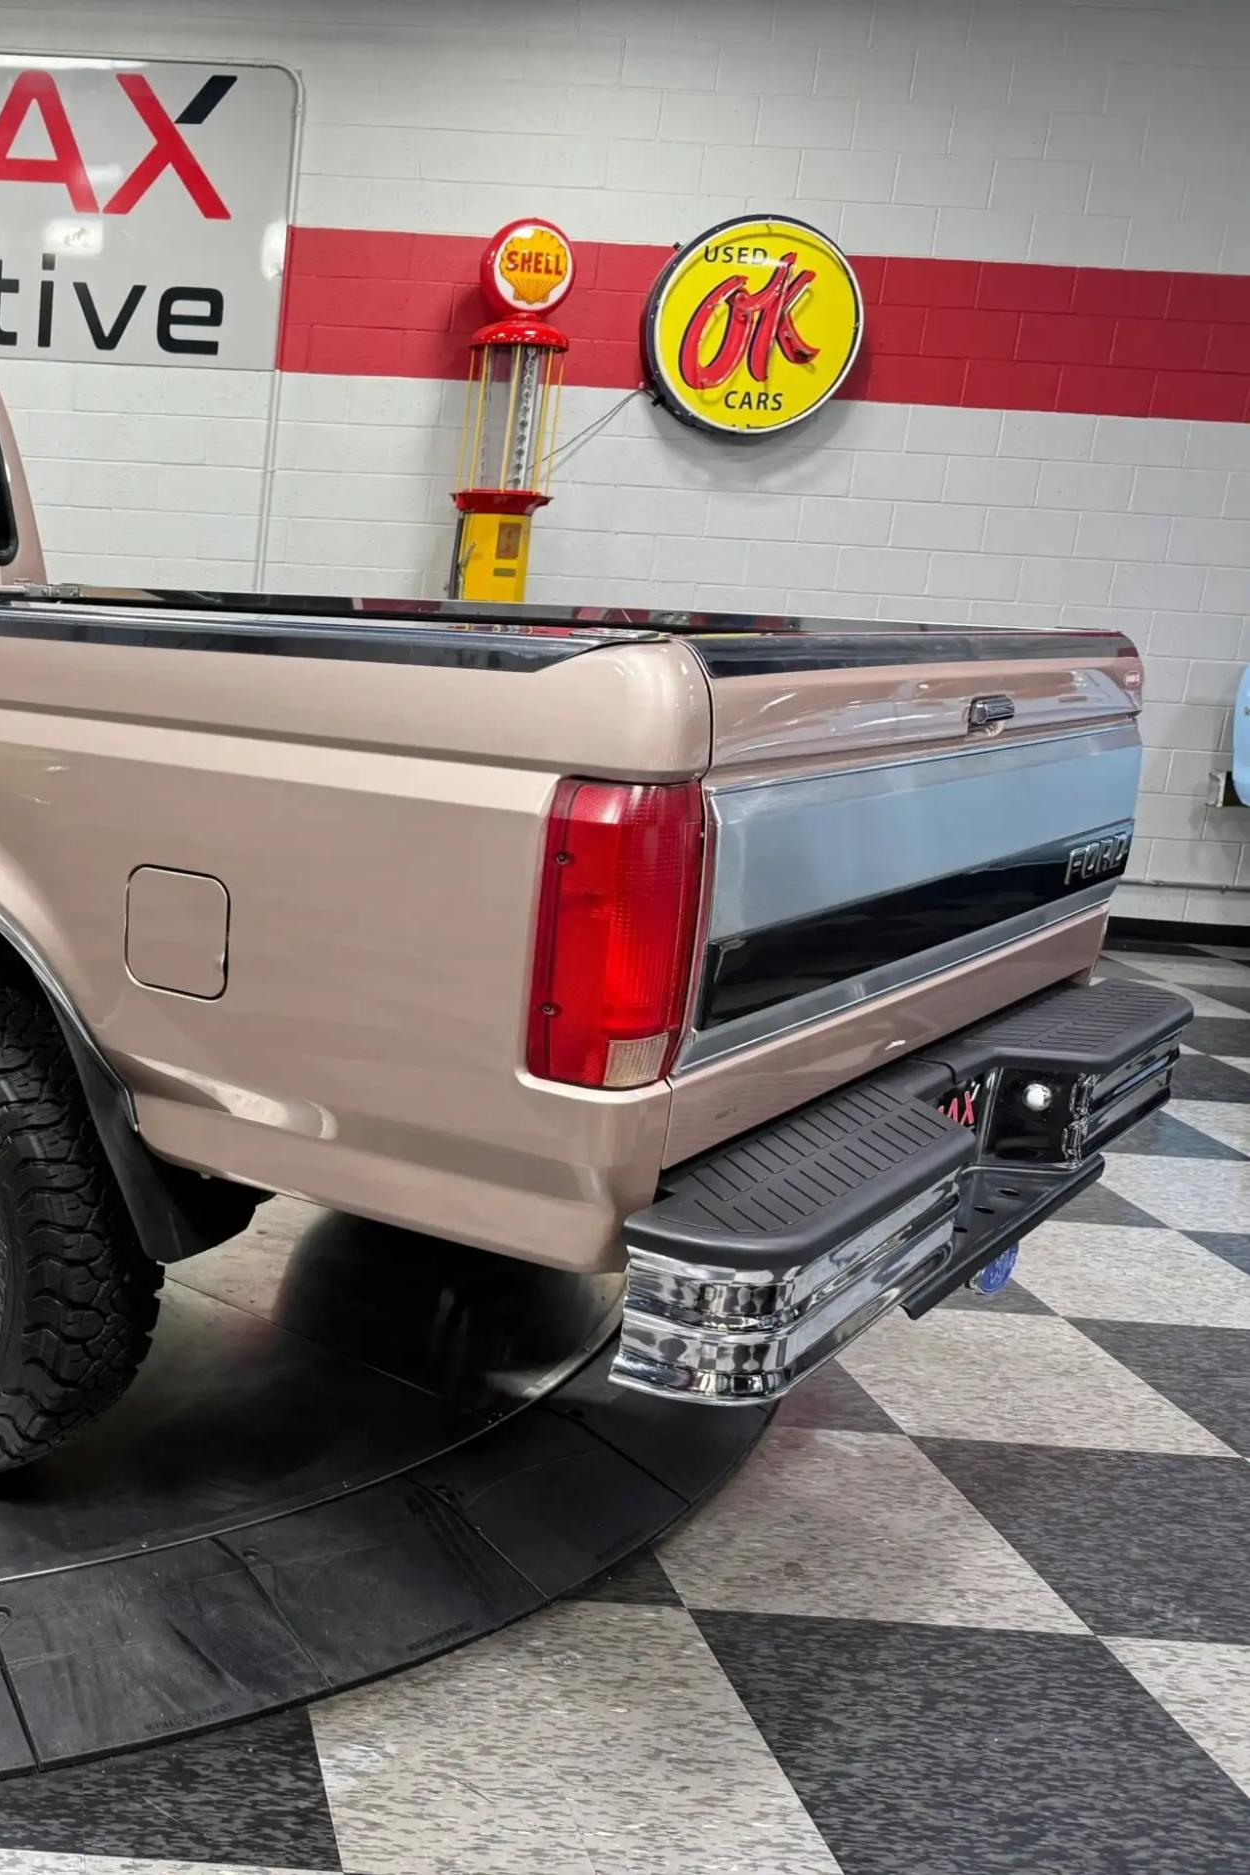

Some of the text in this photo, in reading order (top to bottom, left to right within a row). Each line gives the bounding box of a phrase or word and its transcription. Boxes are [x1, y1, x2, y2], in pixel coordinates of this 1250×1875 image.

[505, 250, 563, 276] SHELL
[703, 246, 768, 265] USED
[679, 251, 821, 390] OK
[724, 391, 784, 411] CARS
[1064, 833, 1128, 886] FORD
